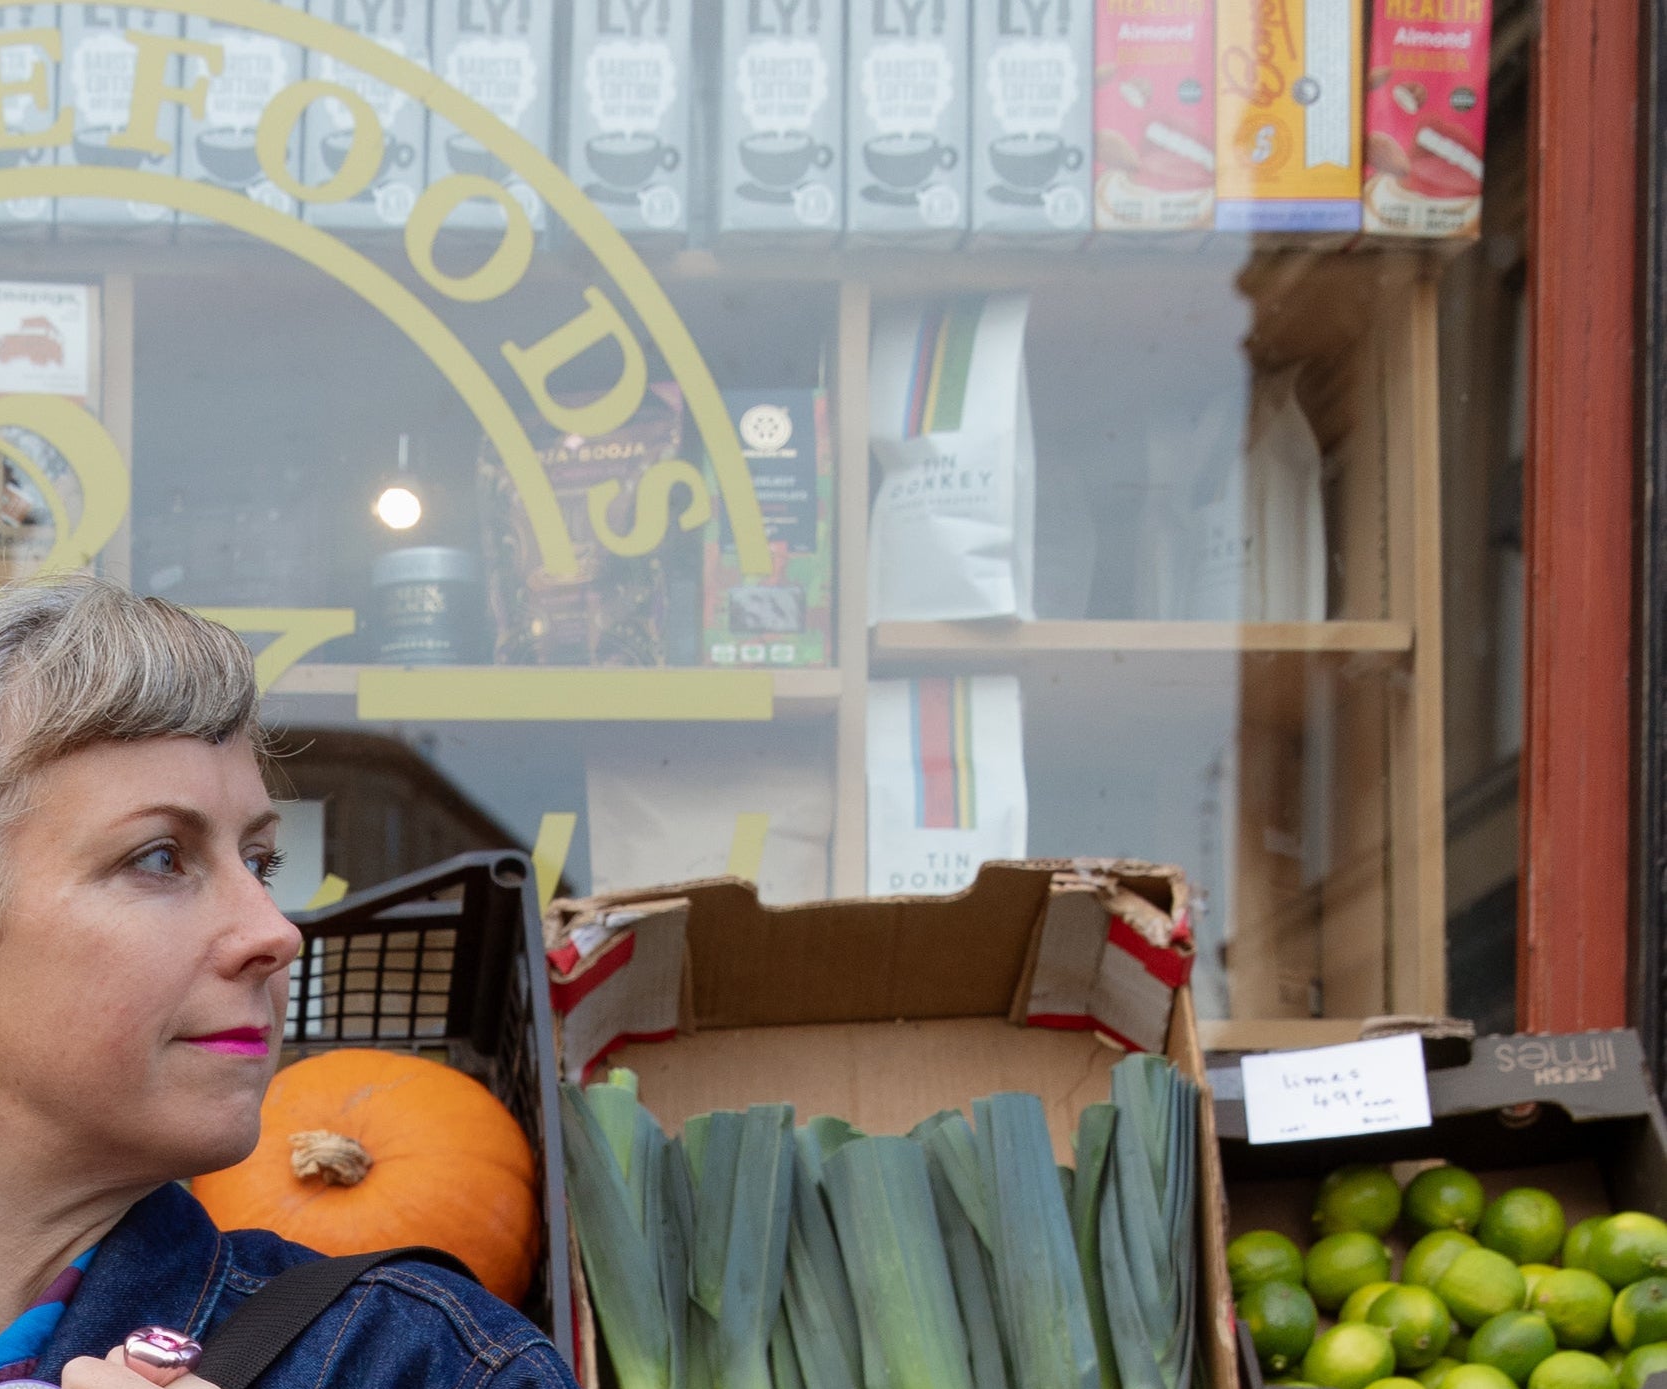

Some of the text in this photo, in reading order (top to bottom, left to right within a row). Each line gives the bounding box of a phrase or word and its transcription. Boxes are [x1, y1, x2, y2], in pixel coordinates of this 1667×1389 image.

[1393, 26, 1472, 48] Almond
[926, 853, 970, 869] TIN
[1494, 1039, 1617, 1073] limes
[1534, 1066, 1608, 1085] FRESH
